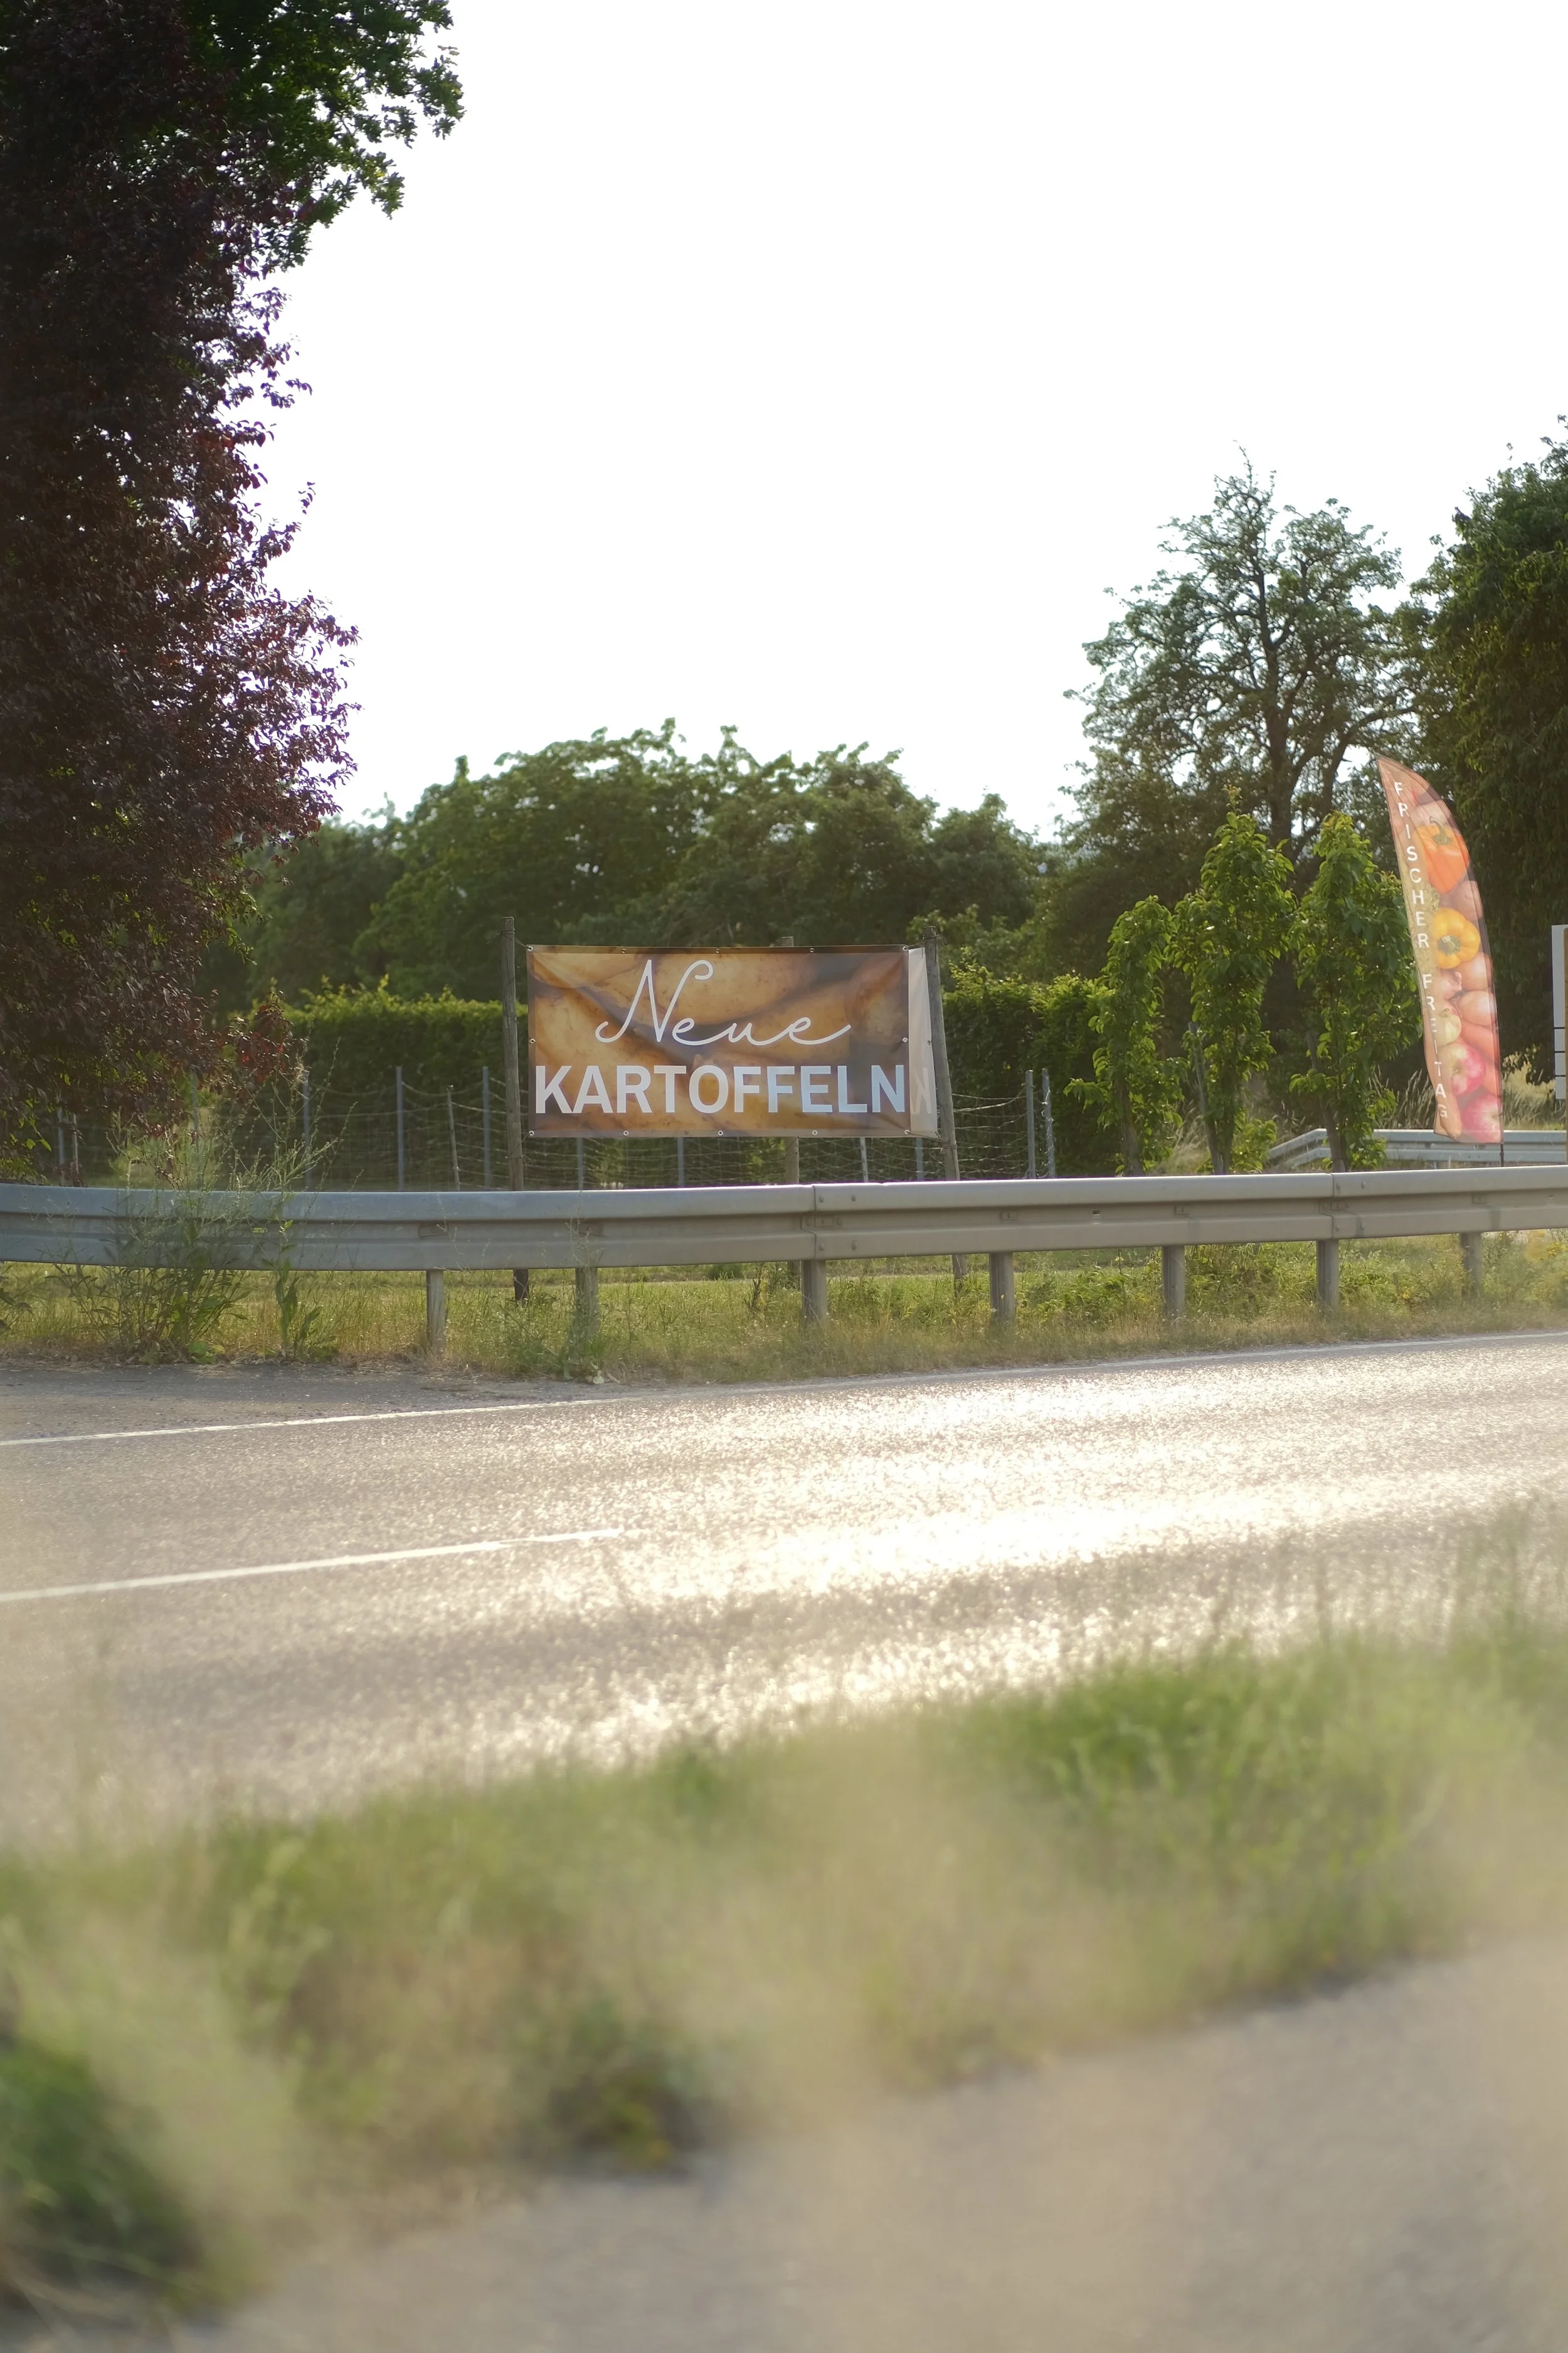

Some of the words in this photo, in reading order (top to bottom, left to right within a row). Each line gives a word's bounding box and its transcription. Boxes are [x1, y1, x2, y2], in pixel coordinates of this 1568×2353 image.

[1394, 782, 1429, 948] FRISCHER
[1422, 974, 1448, 1118] FREITAG
[595, 959, 851, 1045] Neue
[535, 1065, 906, 1114] KARTOFFELN
